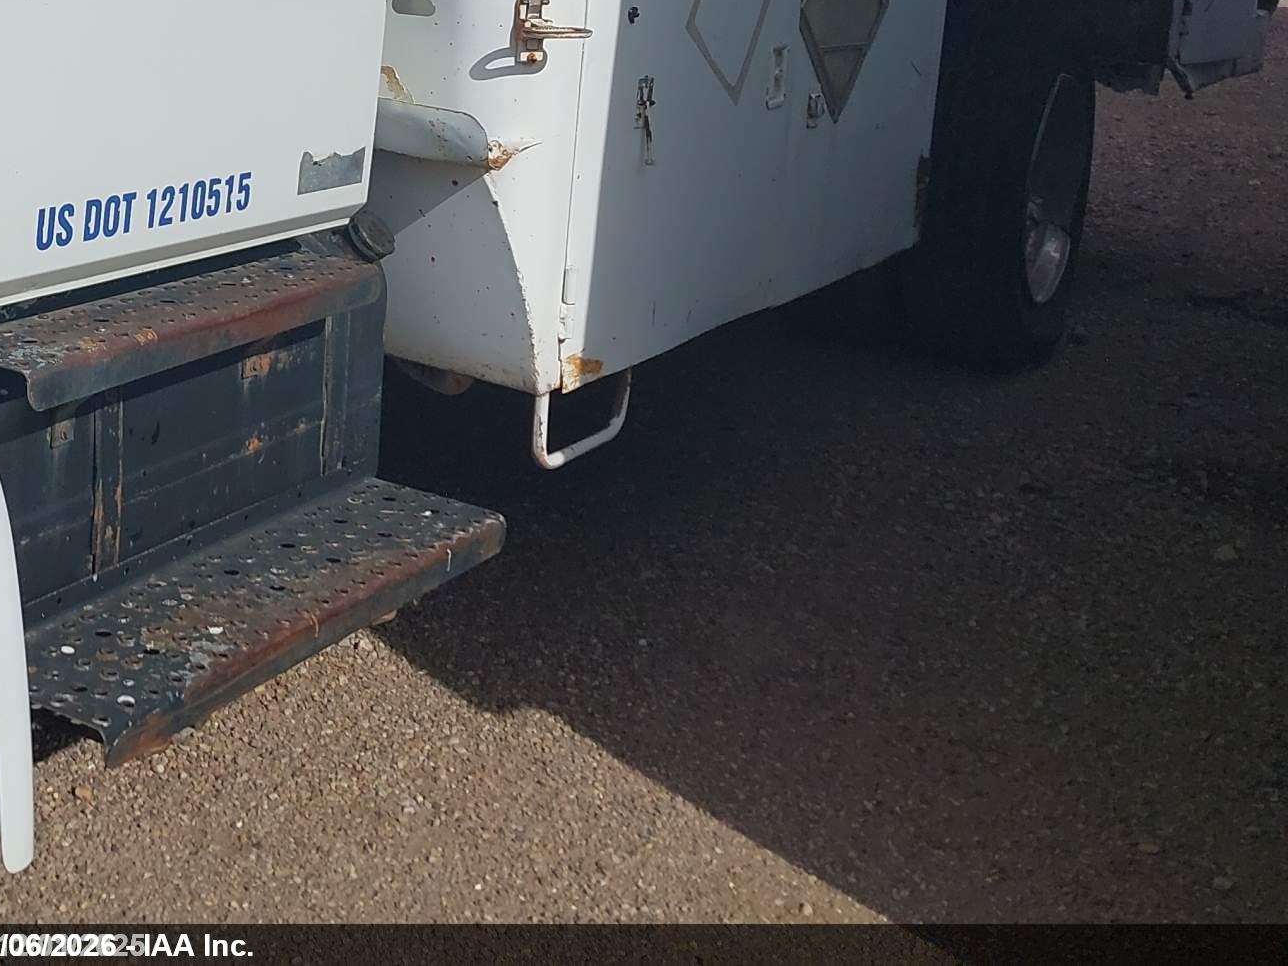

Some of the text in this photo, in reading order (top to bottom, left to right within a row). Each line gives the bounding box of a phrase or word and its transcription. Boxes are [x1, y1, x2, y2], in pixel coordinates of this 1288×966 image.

[35, 171, 252, 251] US DOT 1210515
